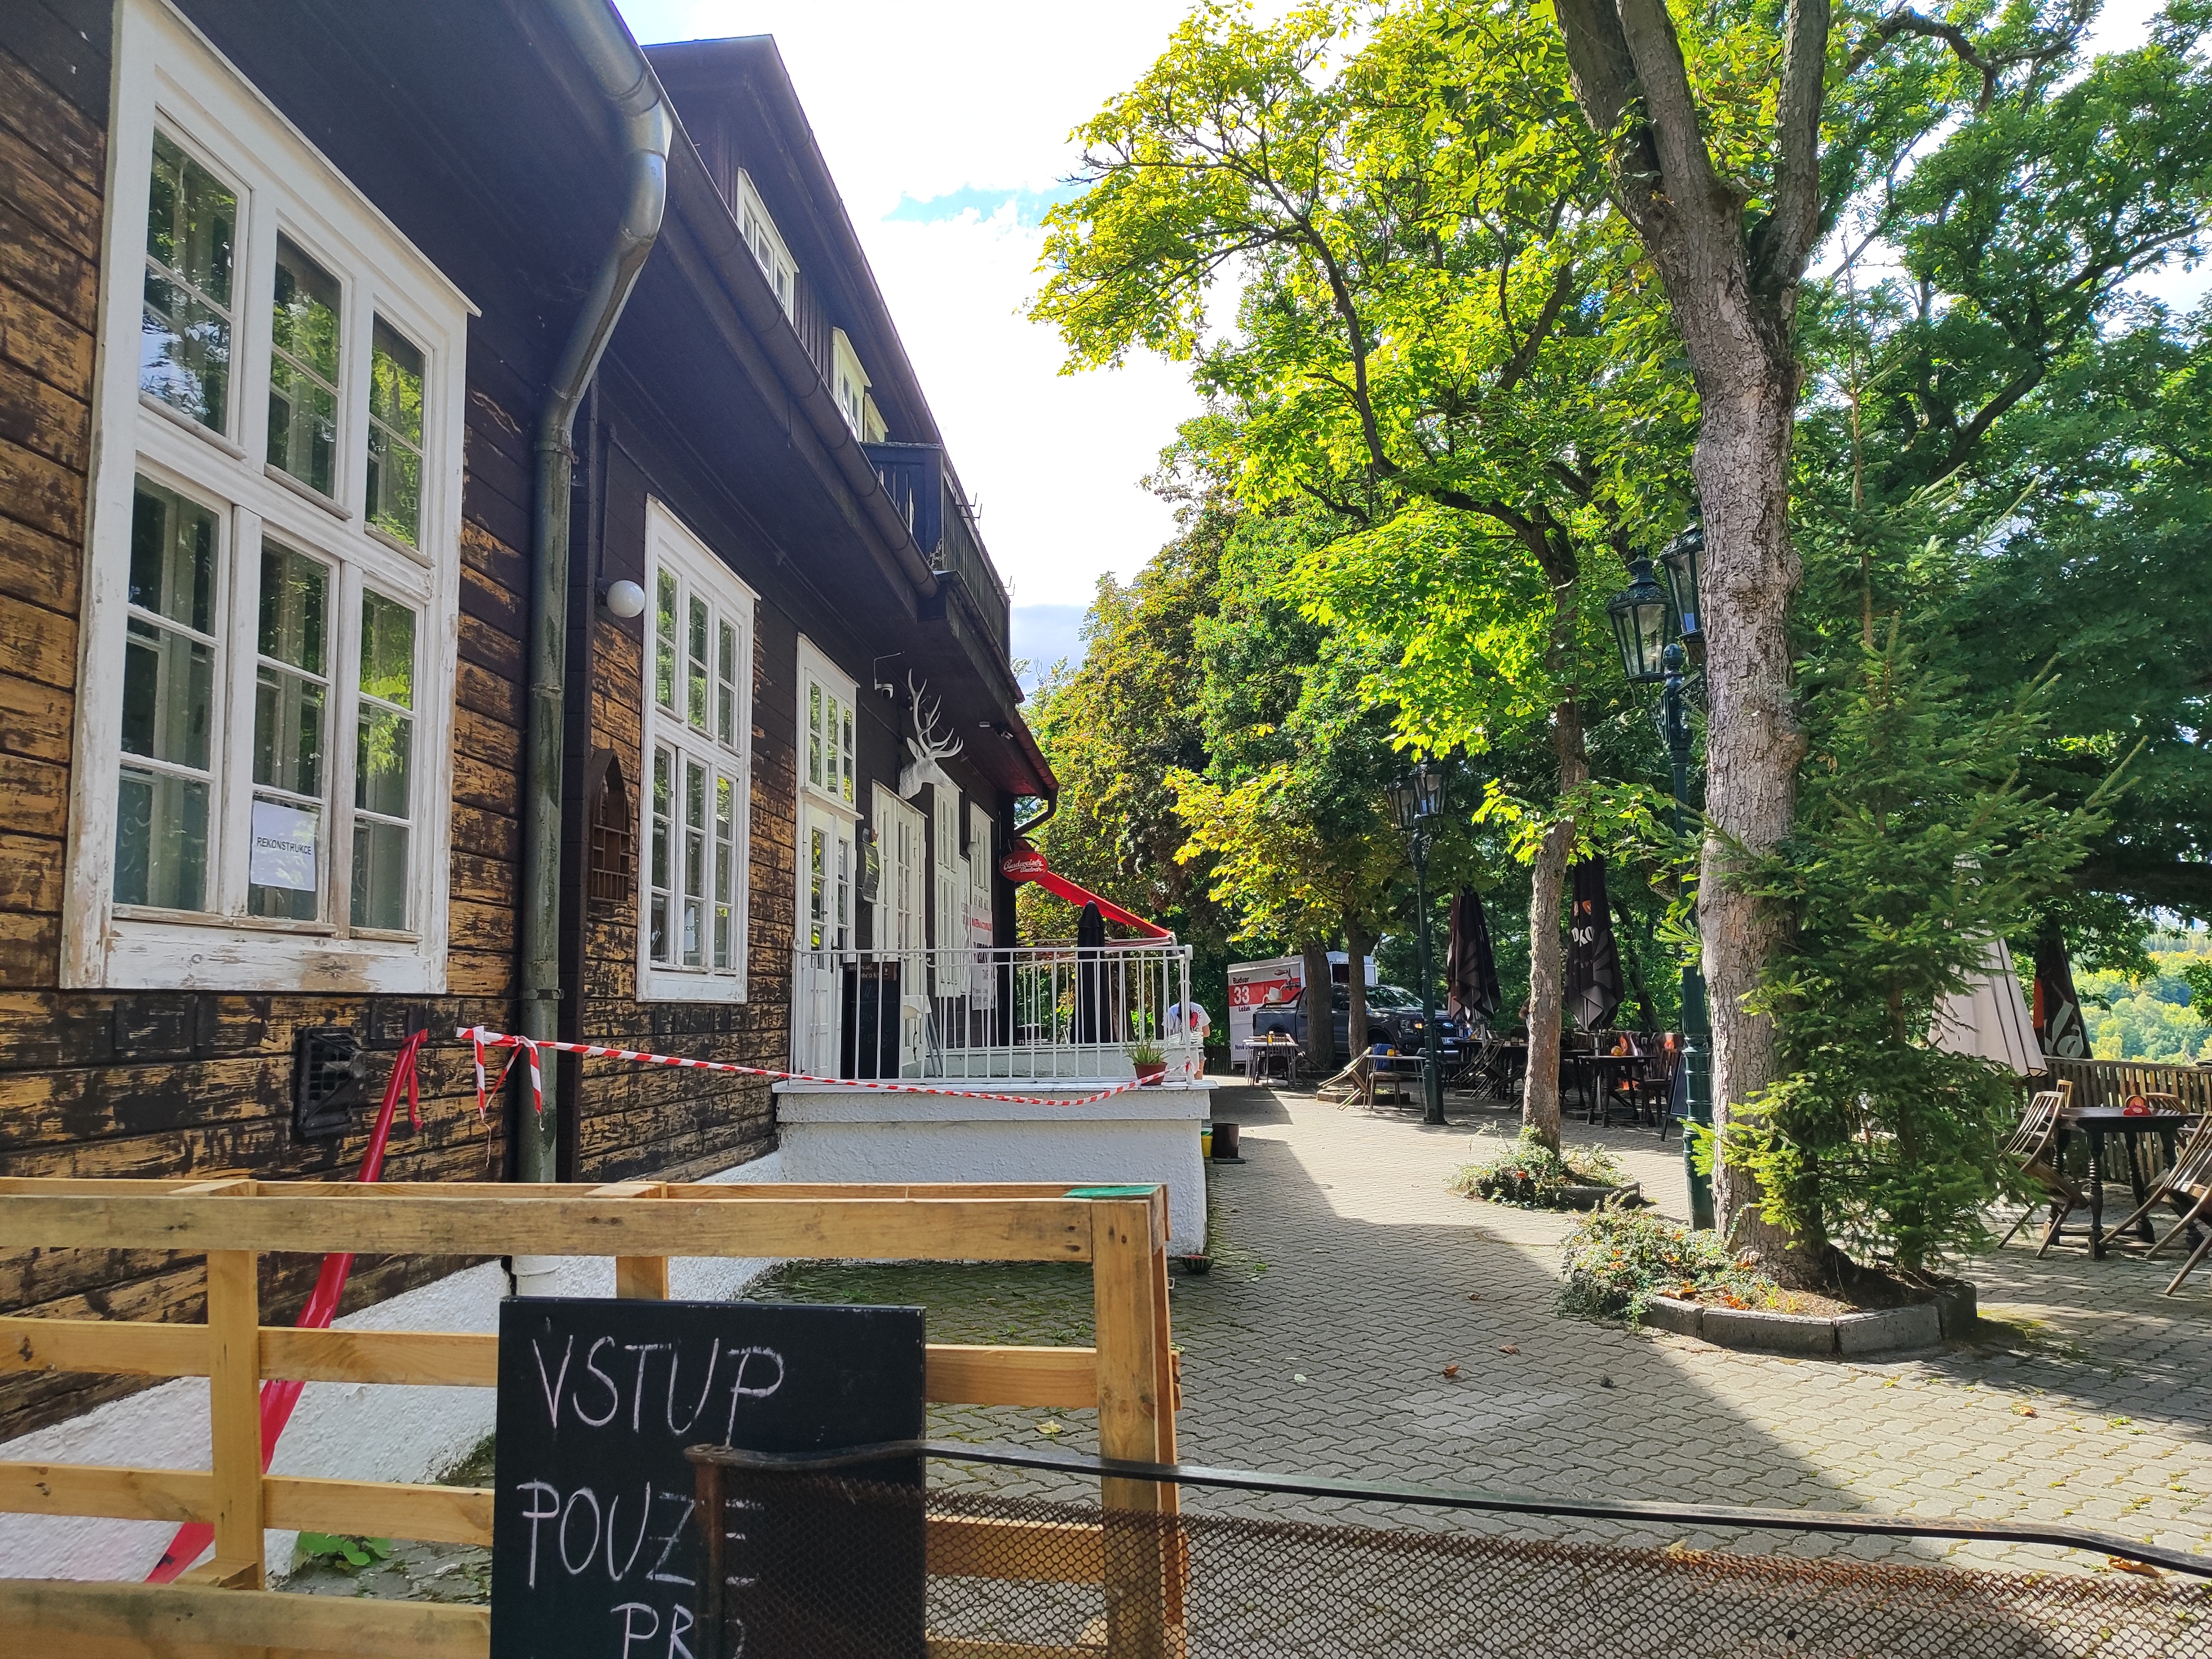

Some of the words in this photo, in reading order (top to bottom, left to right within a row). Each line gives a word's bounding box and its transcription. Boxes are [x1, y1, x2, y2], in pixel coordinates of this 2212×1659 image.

[257, 837, 311, 855] REKONSTRUKCE
[1003, 859, 1044, 871] Budweiser
[1234, 985, 1250, 1004] 33
[533, 1334, 784, 1447] VSTUP
